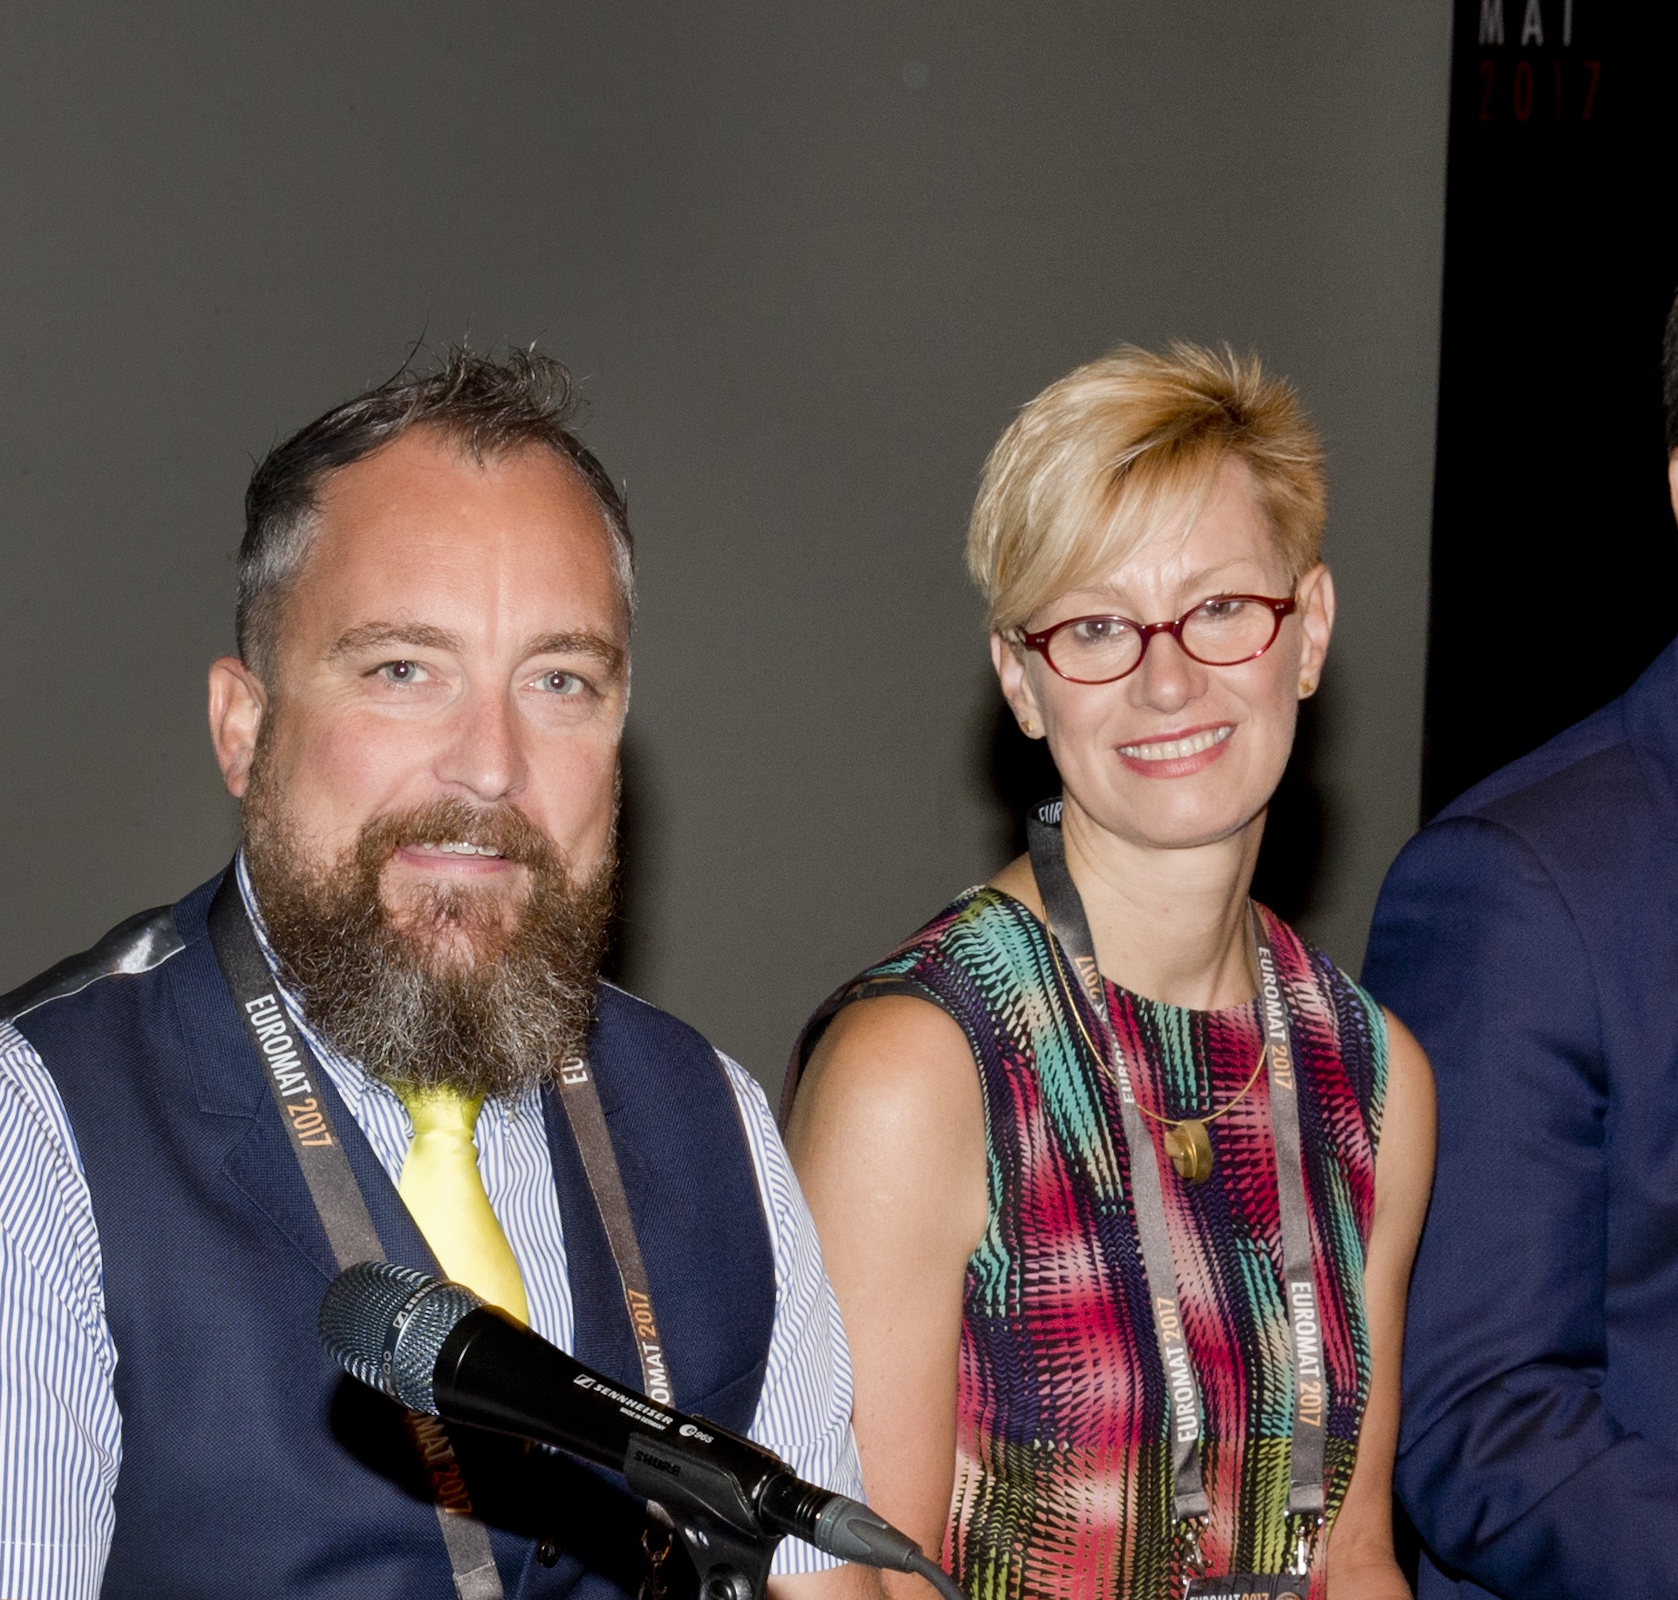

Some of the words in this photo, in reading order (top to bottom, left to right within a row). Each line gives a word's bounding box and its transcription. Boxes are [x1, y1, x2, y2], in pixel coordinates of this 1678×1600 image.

[1478, 60, 1601, 122] 2017
[1258, 946, 1286, 1042] EUROMAT
[1272, 1044, 1293, 1090] 2017
[245, 994, 312, 1097] EUROMAT
[287, 1097, 333, 1147] 2017
[626, 1289, 657, 1338] 2017
[1157, 1297, 1181, 1343] 2017
[1291, 1281, 1320, 1377] EUROMAT
[593, 1383, 674, 1425] SENNHEISER
[1166, 1347, 1198, 1443] EUROMAT
[1298, 1380, 1322, 1427] 2017
[633, 1450, 681, 1477] SHURE
